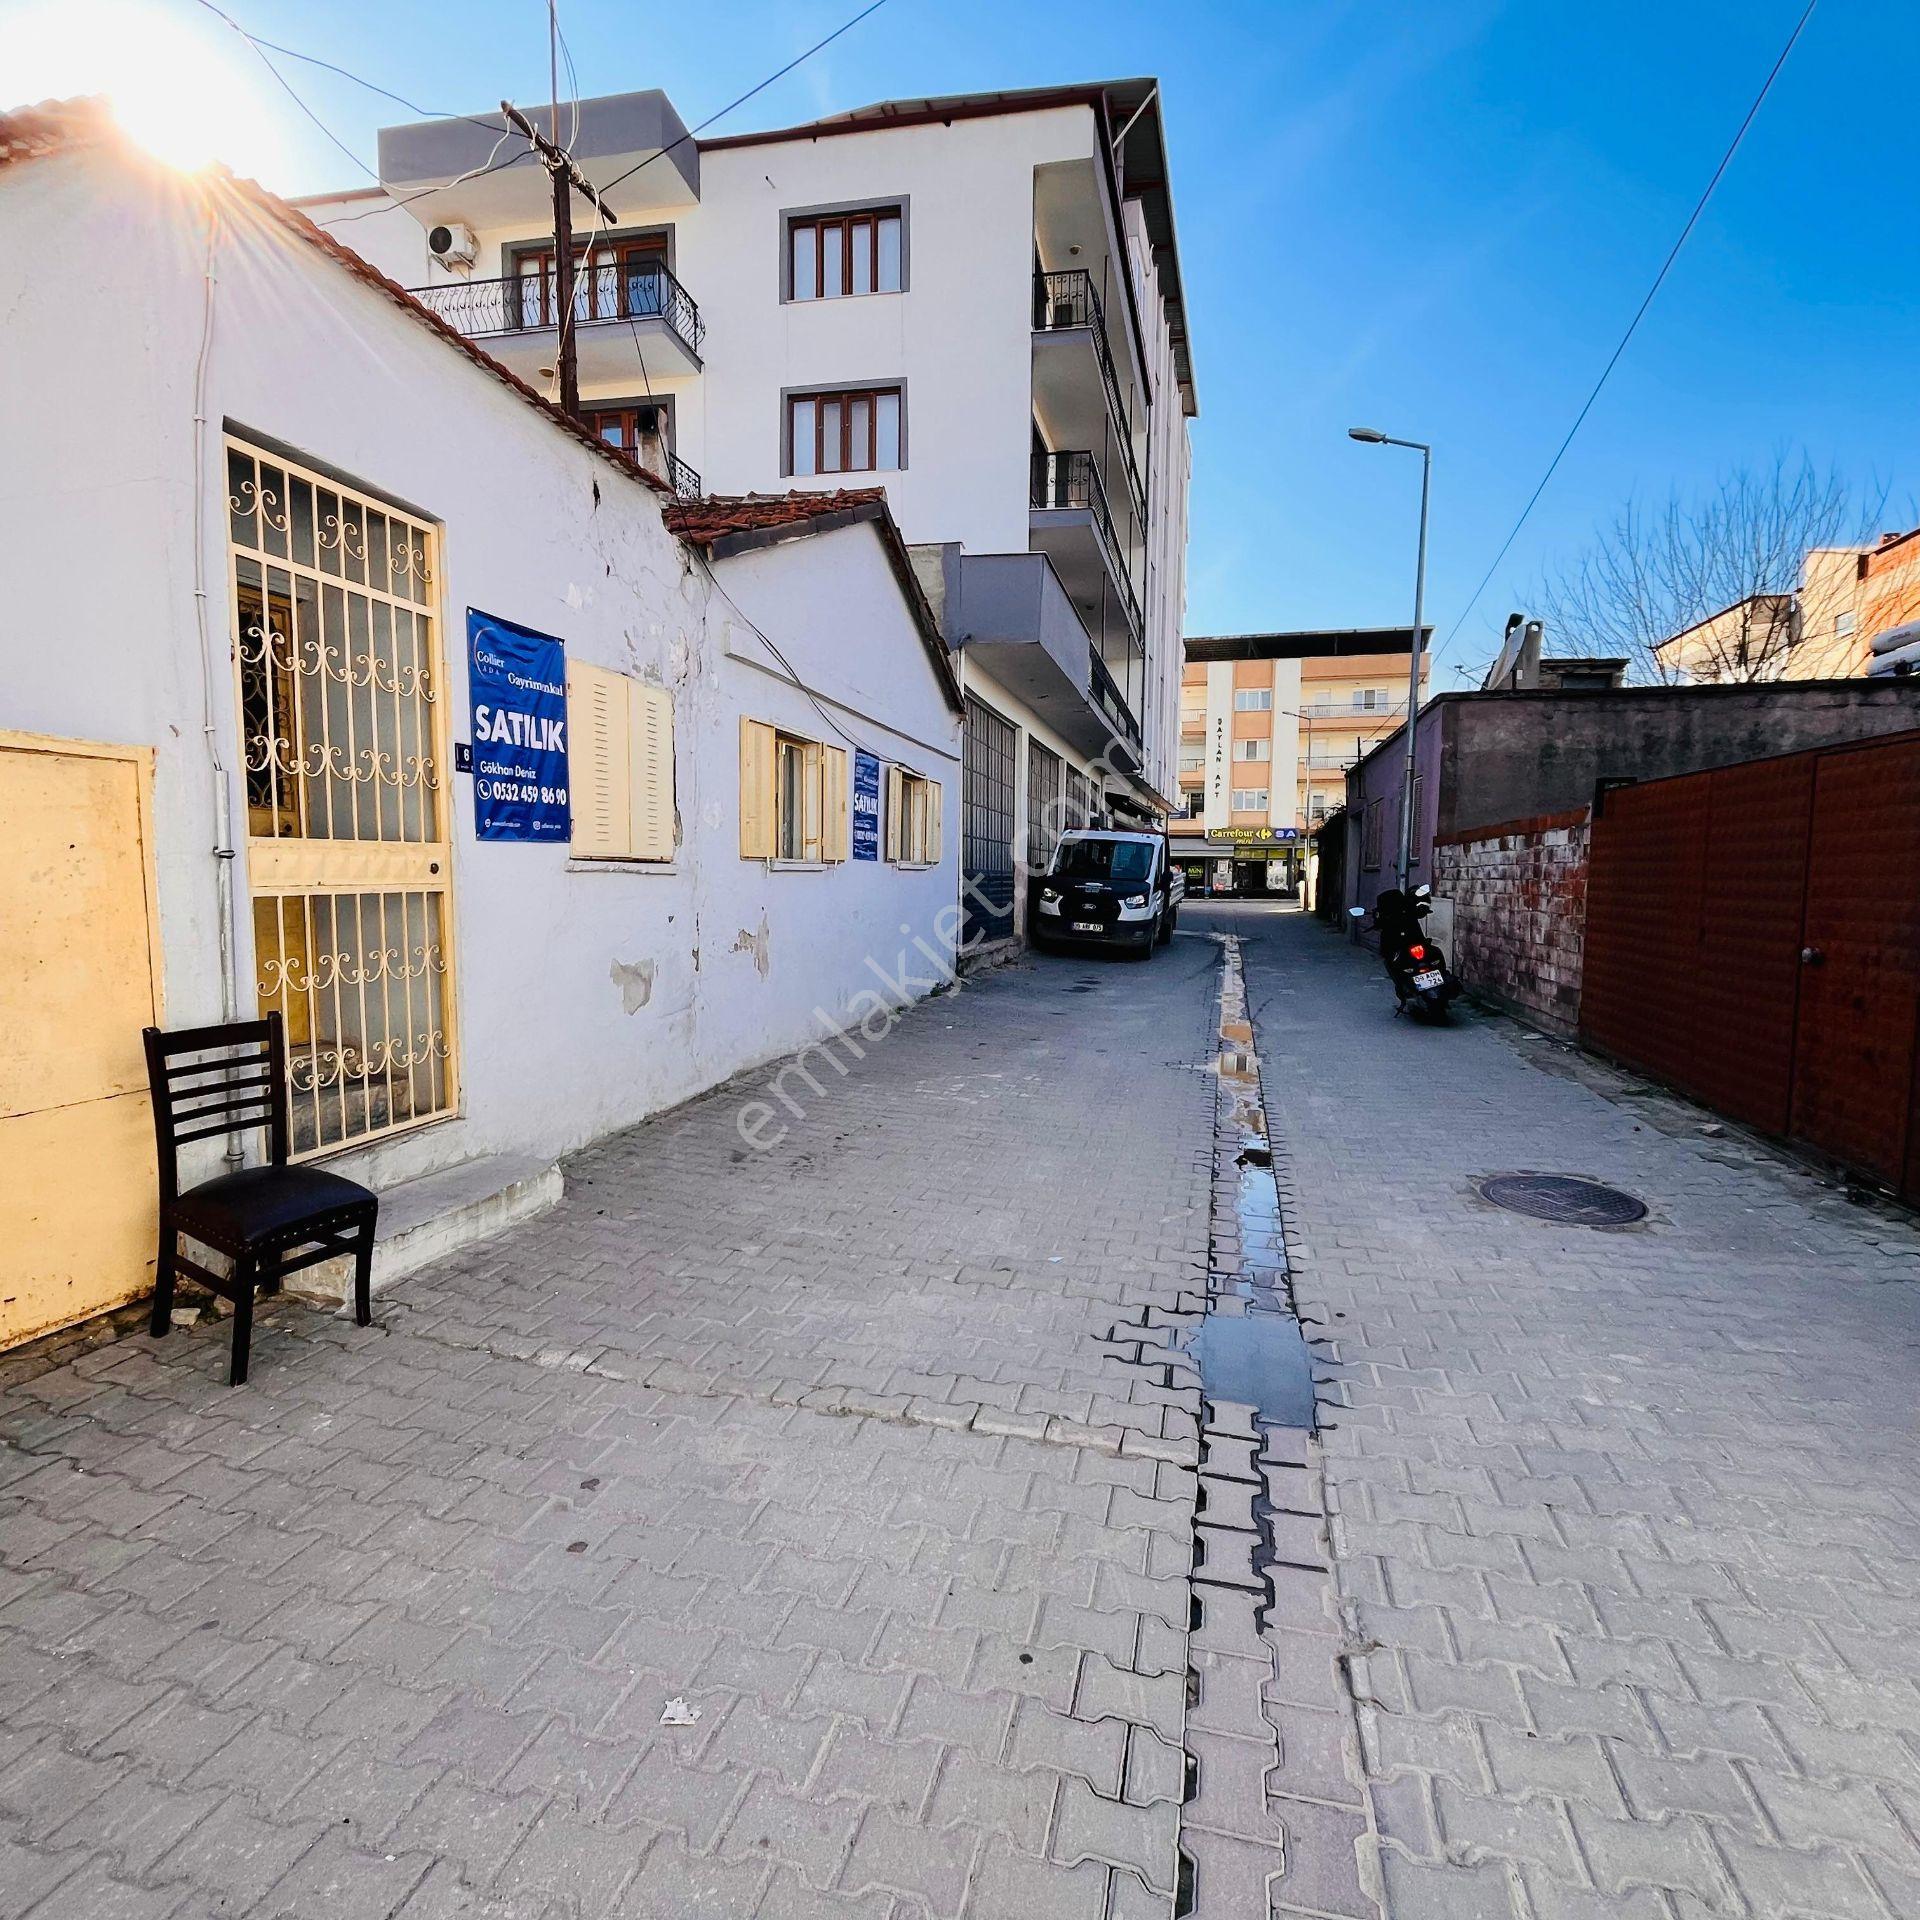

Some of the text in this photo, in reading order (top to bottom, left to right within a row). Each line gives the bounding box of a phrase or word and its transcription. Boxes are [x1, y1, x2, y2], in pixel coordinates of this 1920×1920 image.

[477, 650, 505, 668] Collier
[475, 704, 566, 754] SATILIK
[480, 760, 514, 776] Gökhan
[515, 765, 537, 779] Deniz
[493, 781, 567, 806] 0532 459 86 90
[1210, 828, 1254, 839] Carrefour
